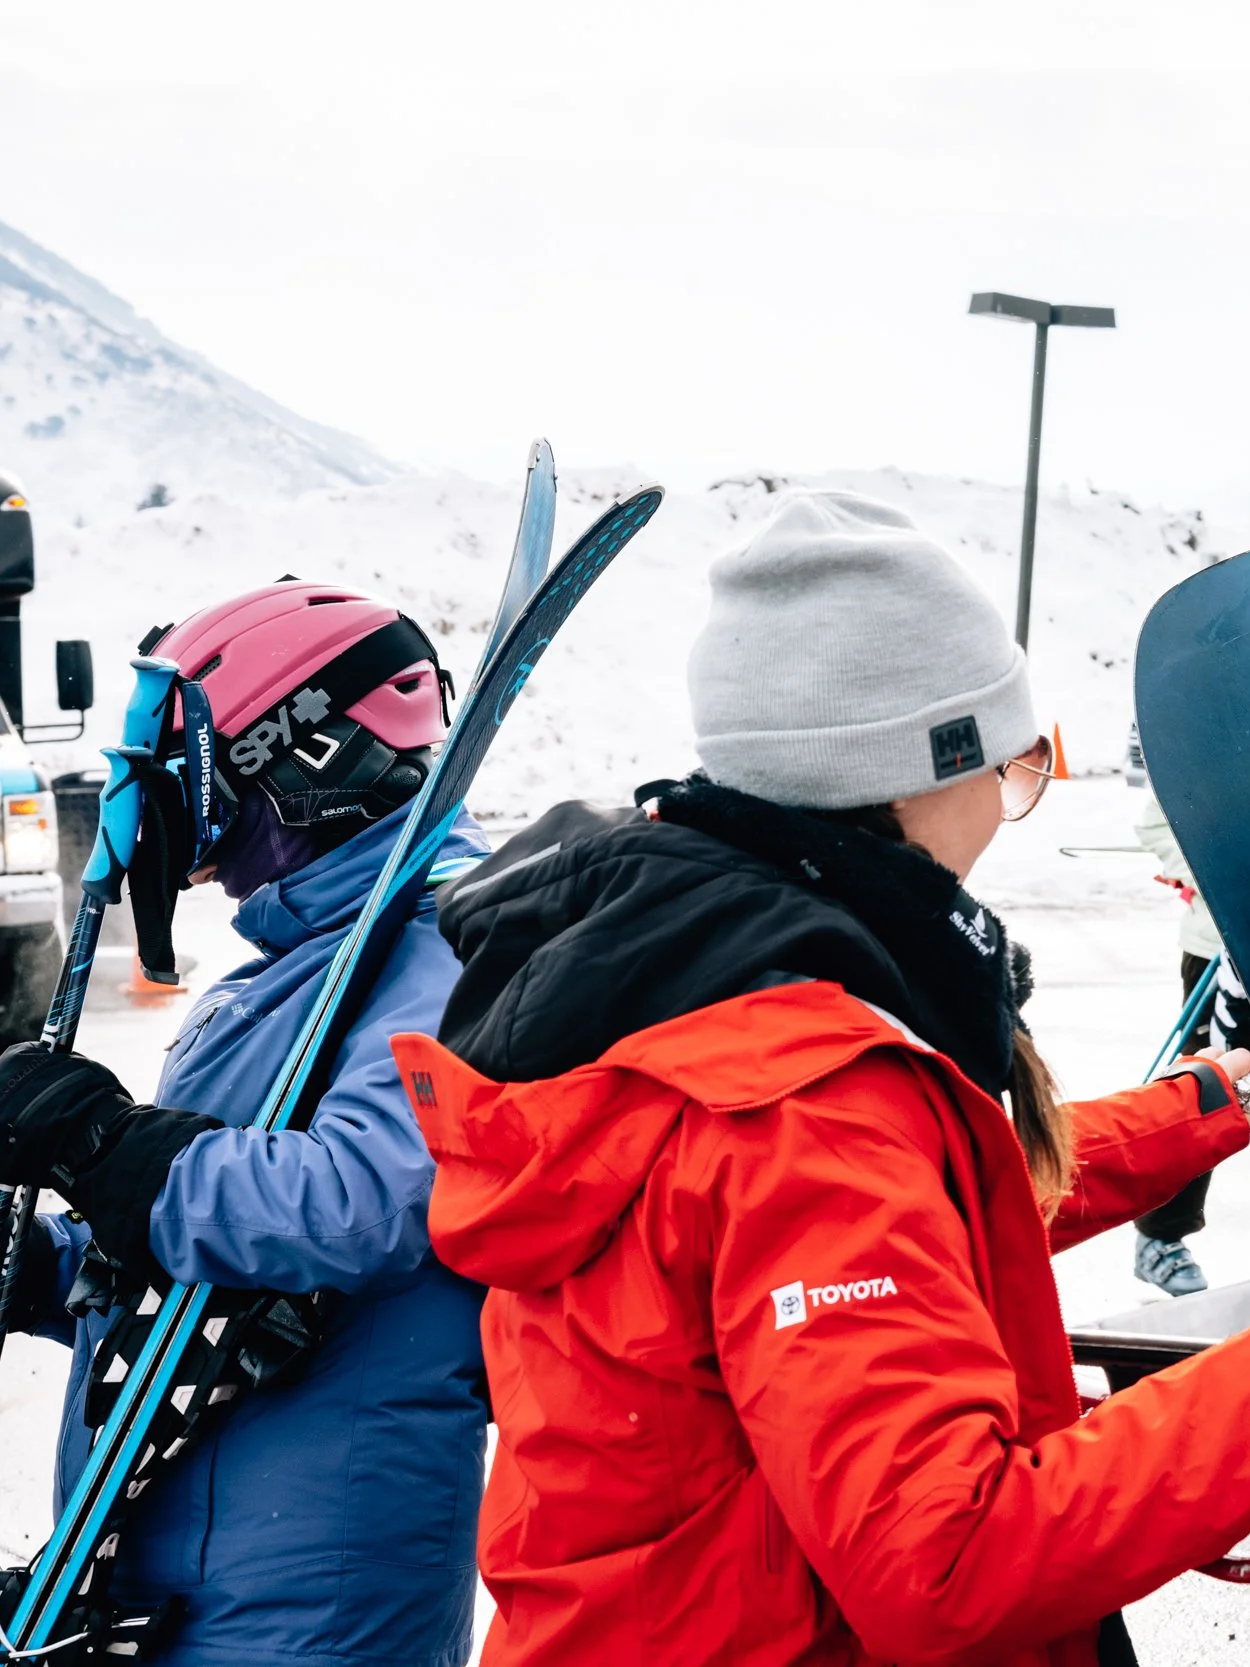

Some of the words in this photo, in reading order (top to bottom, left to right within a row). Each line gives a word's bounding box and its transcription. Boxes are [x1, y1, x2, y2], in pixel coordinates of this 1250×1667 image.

[935, 723, 975, 757] HH
[198, 723, 211, 817] ROSSIGNOL
[411, 1071, 438, 1106] HH
[806, 1276, 898, 1307] TOYOTA
